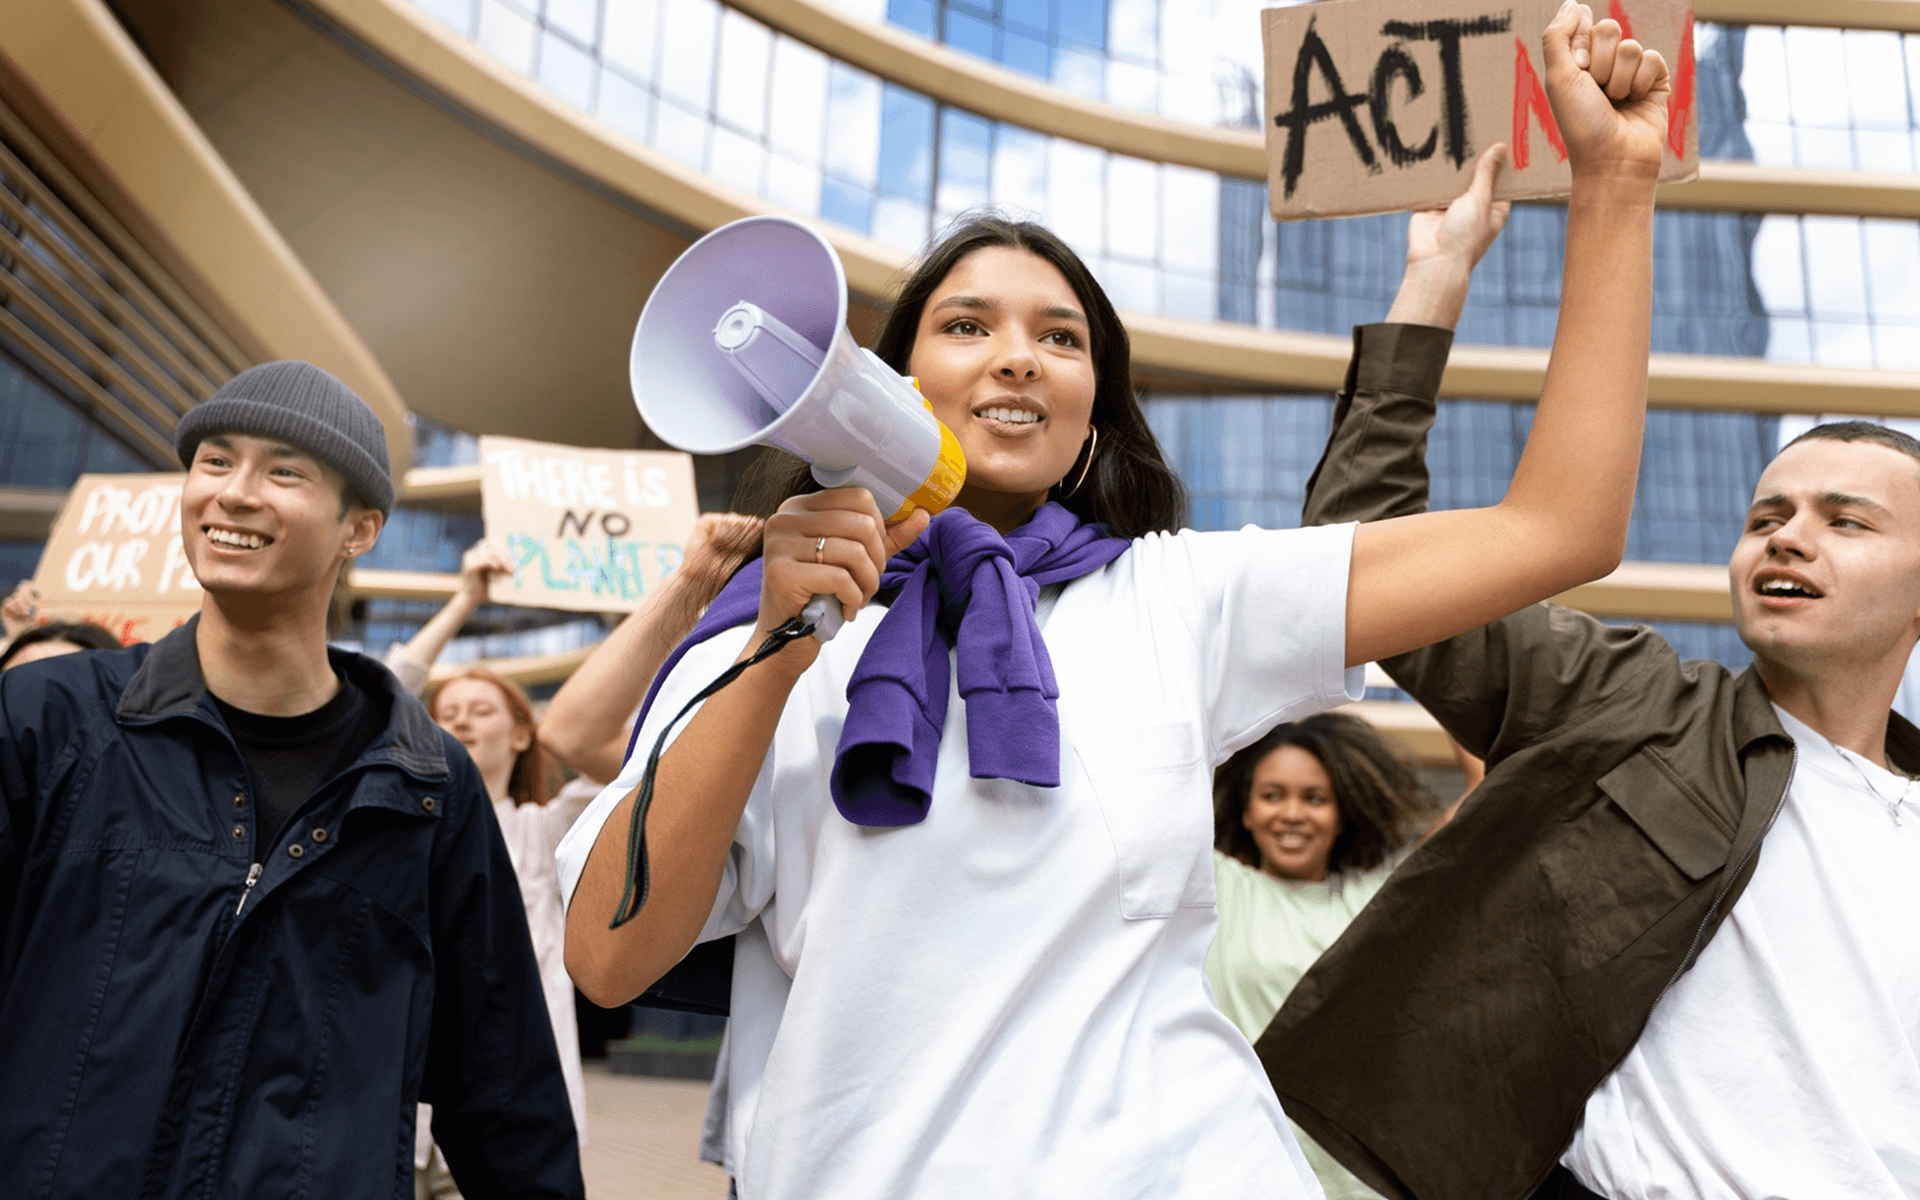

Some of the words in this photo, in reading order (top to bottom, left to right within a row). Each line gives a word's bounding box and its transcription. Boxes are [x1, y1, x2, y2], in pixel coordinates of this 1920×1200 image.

[1274, 10, 1512, 200] ACT
[486, 450, 617, 508] THERE
[556, 508, 630, 539] NO
[64, 538, 150, 592] OUR
[507, 534, 651, 600] PLANET
